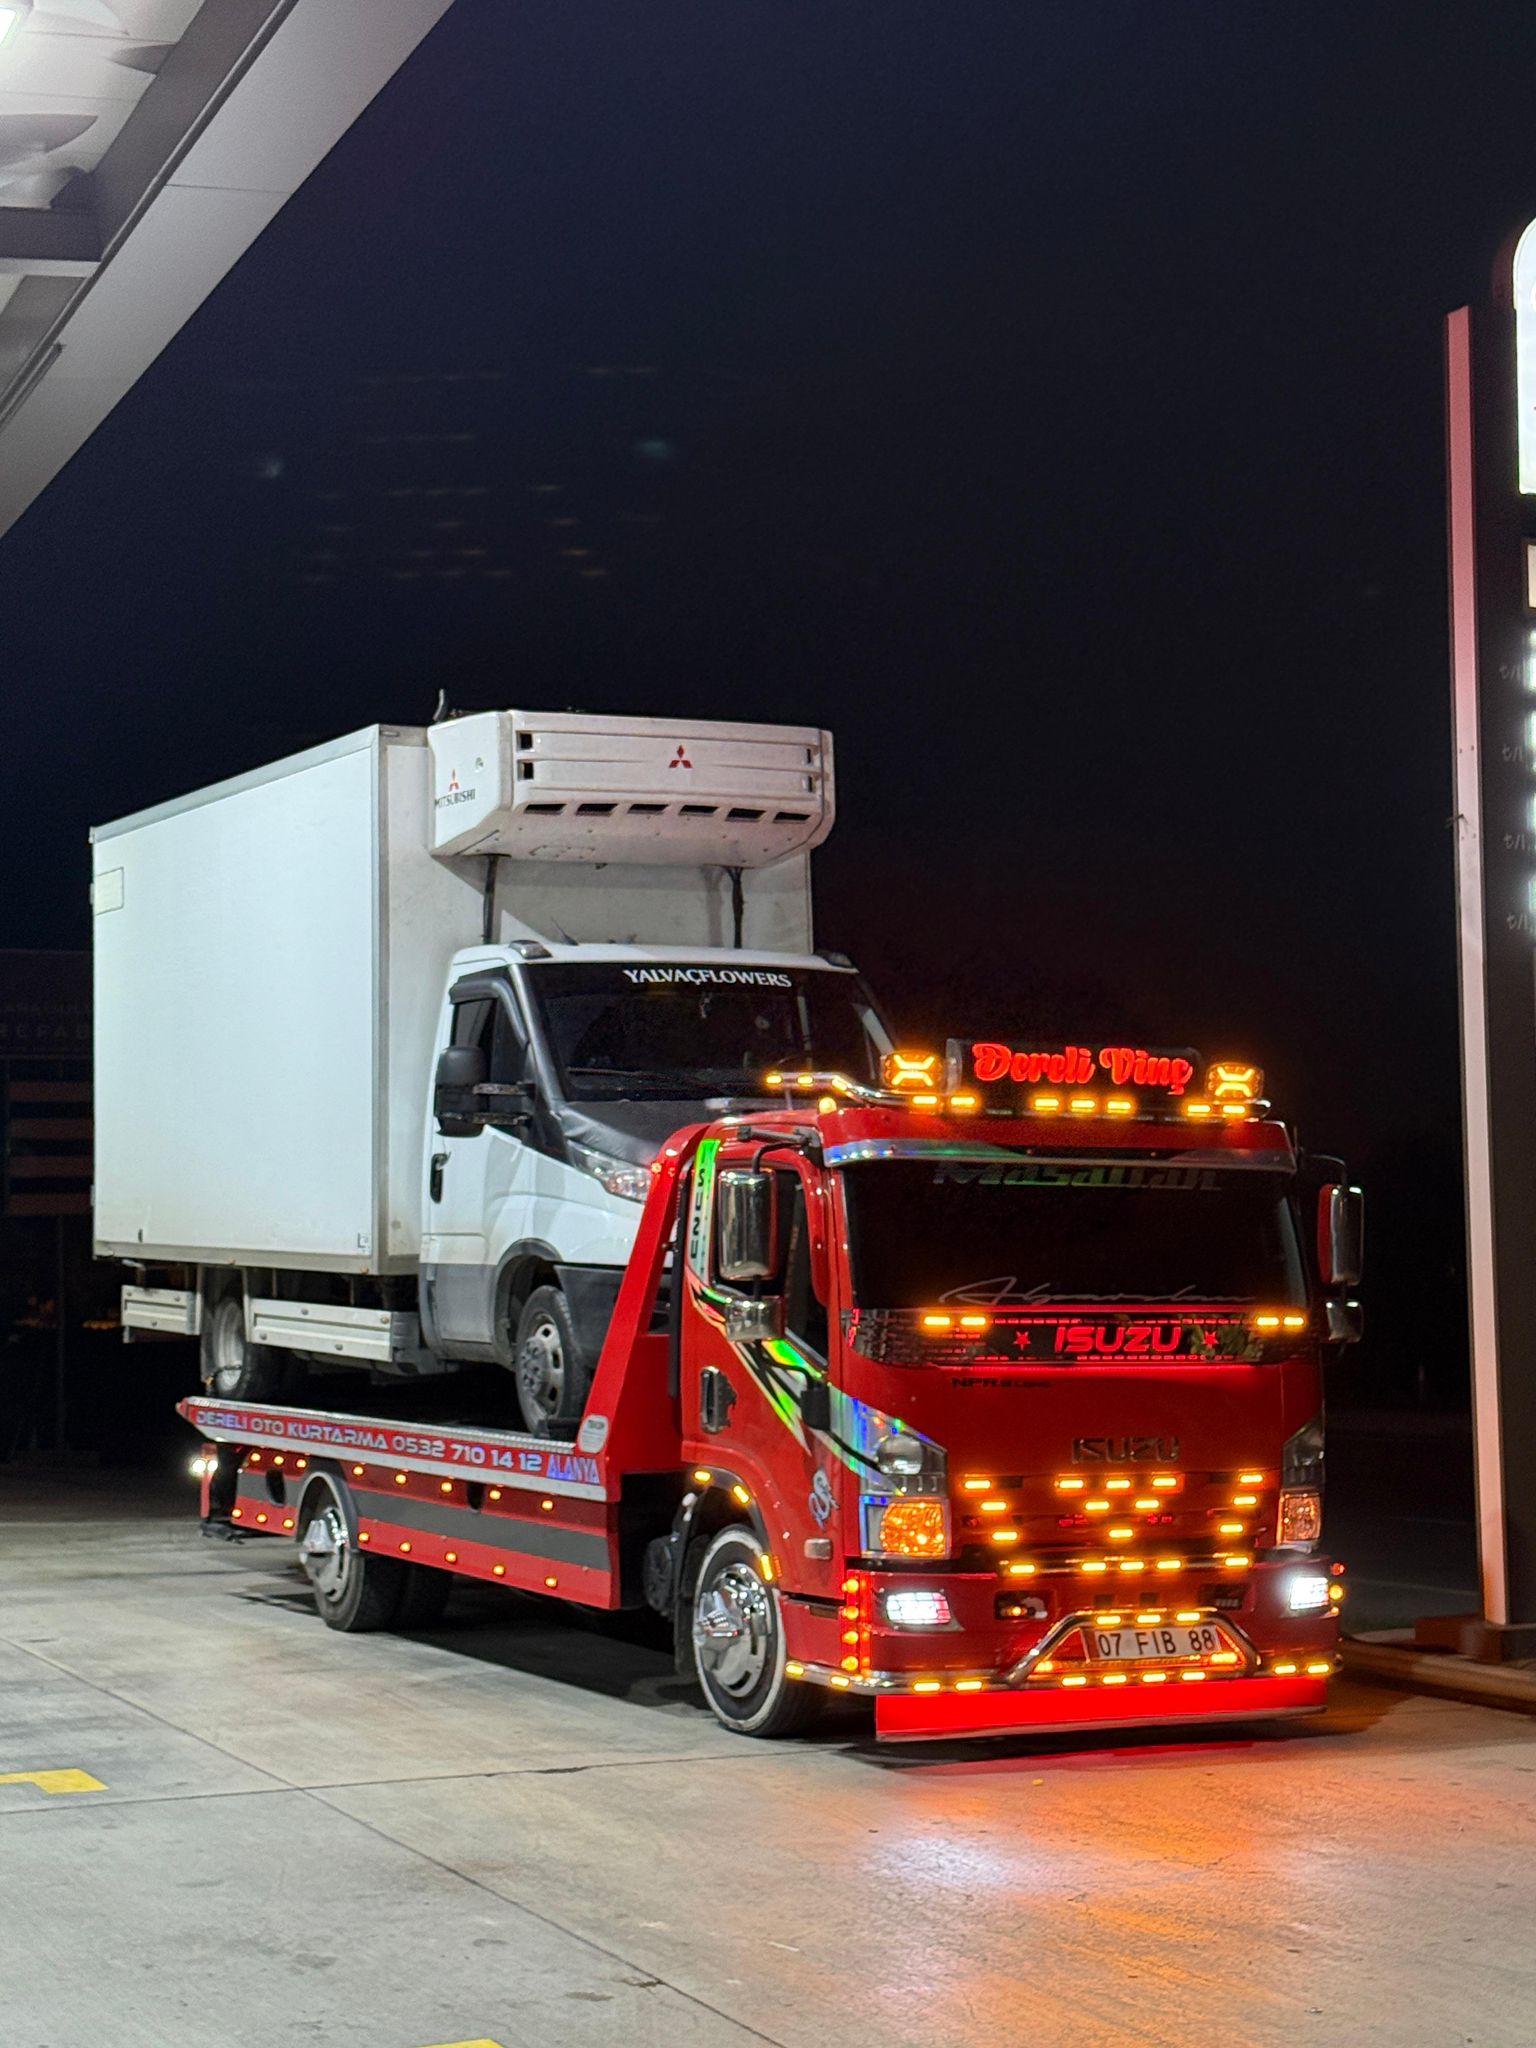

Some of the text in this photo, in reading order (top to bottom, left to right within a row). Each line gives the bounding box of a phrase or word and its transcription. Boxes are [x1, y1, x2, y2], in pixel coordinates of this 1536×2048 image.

[434, 788, 476, 809] MITSUBISHI
[623, 969, 792, 988] YALVAÇFLOWERS
[972, 1042, 1096, 1083] Dereli
[1054, 1326, 1181, 1353] ISUZU
[252, 1417, 284, 1435] OTO
[287, 1423, 388, 1449] KURTARMA
[392, 1435, 446, 1458] 0532
[451, 1444, 485, 1464] 710
[490, 1449, 514, 1468] 14
[518, 1453, 543, 1472] 12
[547, 1454, 600, 1484] ALANYA
[1072, 1437, 1180, 1464] ISUZU
[1098, 1629, 1215, 1657] 07 FIB 88
